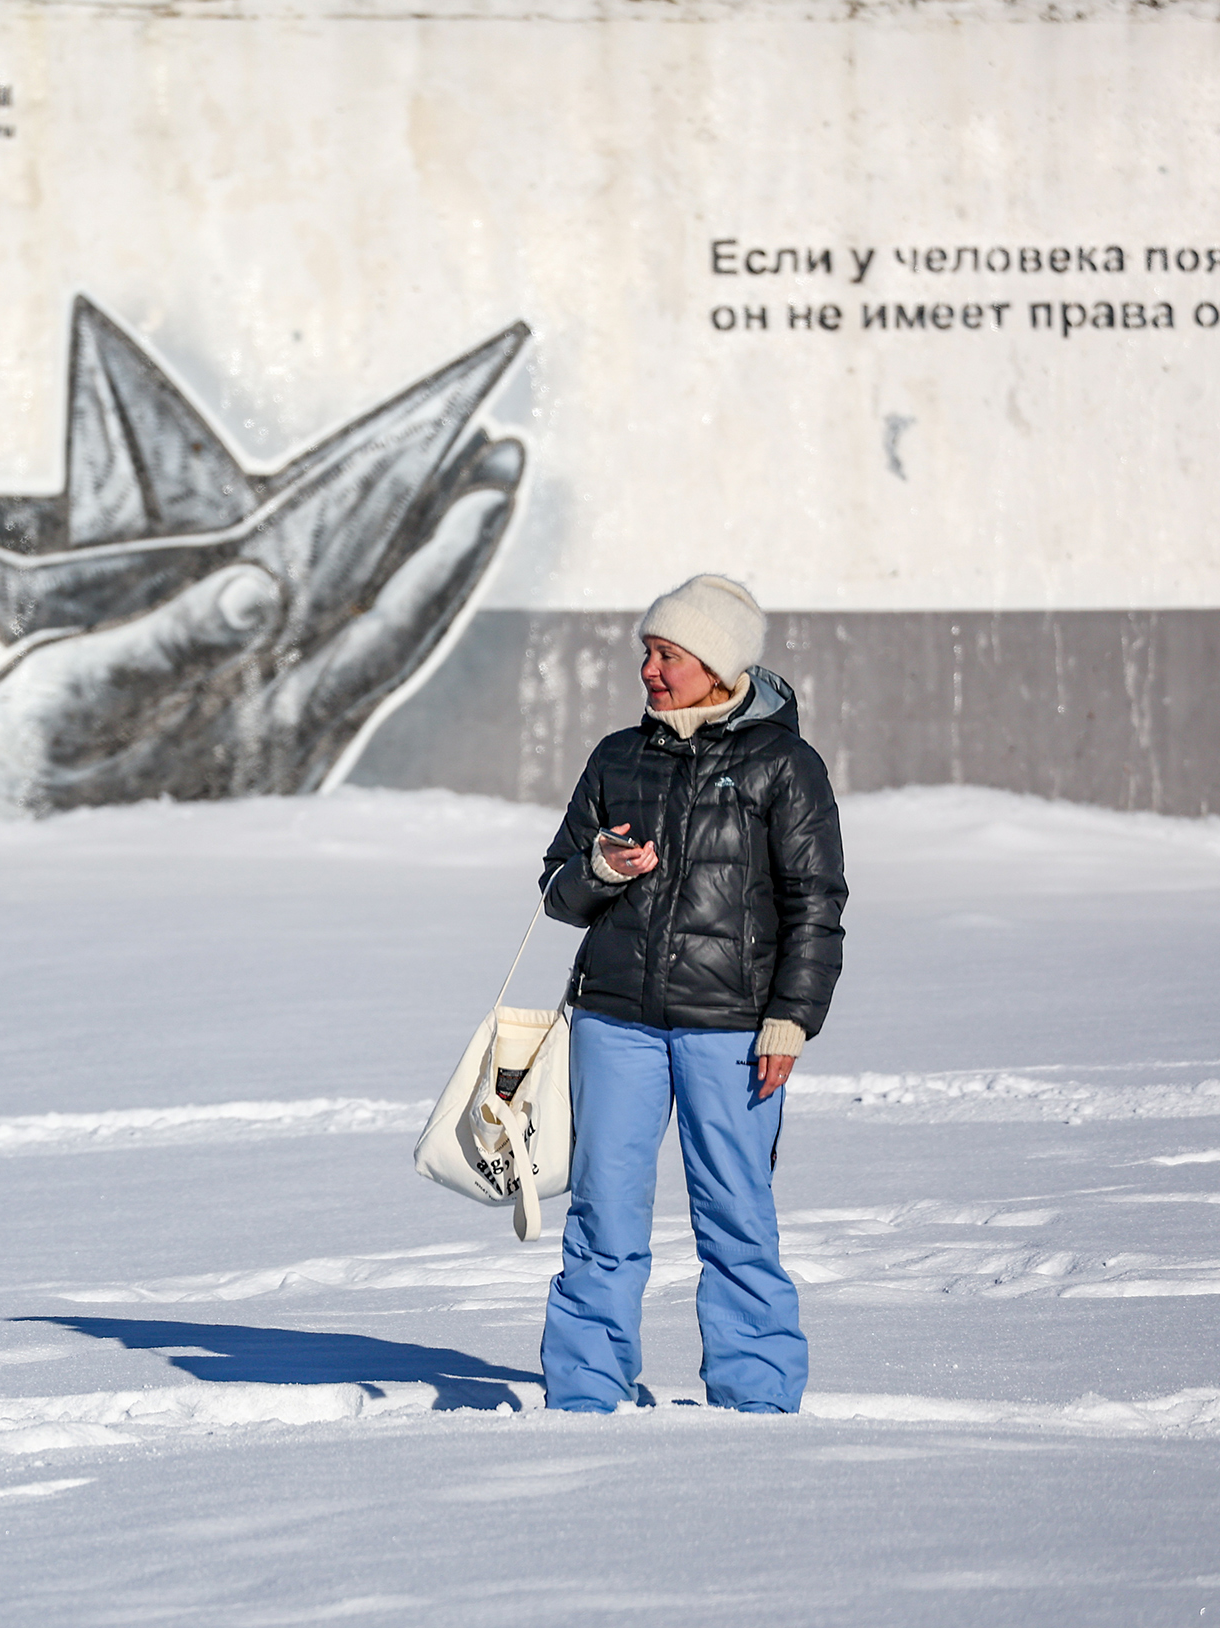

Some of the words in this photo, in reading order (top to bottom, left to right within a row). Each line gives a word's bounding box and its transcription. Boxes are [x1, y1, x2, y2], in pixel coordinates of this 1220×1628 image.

[711, 239, 831, 275] Если
[849, 246, 876, 283] у
[895, 246, 1125, 273] человека
[711, 304, 768, 331] он
[787, 302, 842, 331] не
[861, 302, 1011, 330] имеет
[1029, 301, 1174, 338] права
